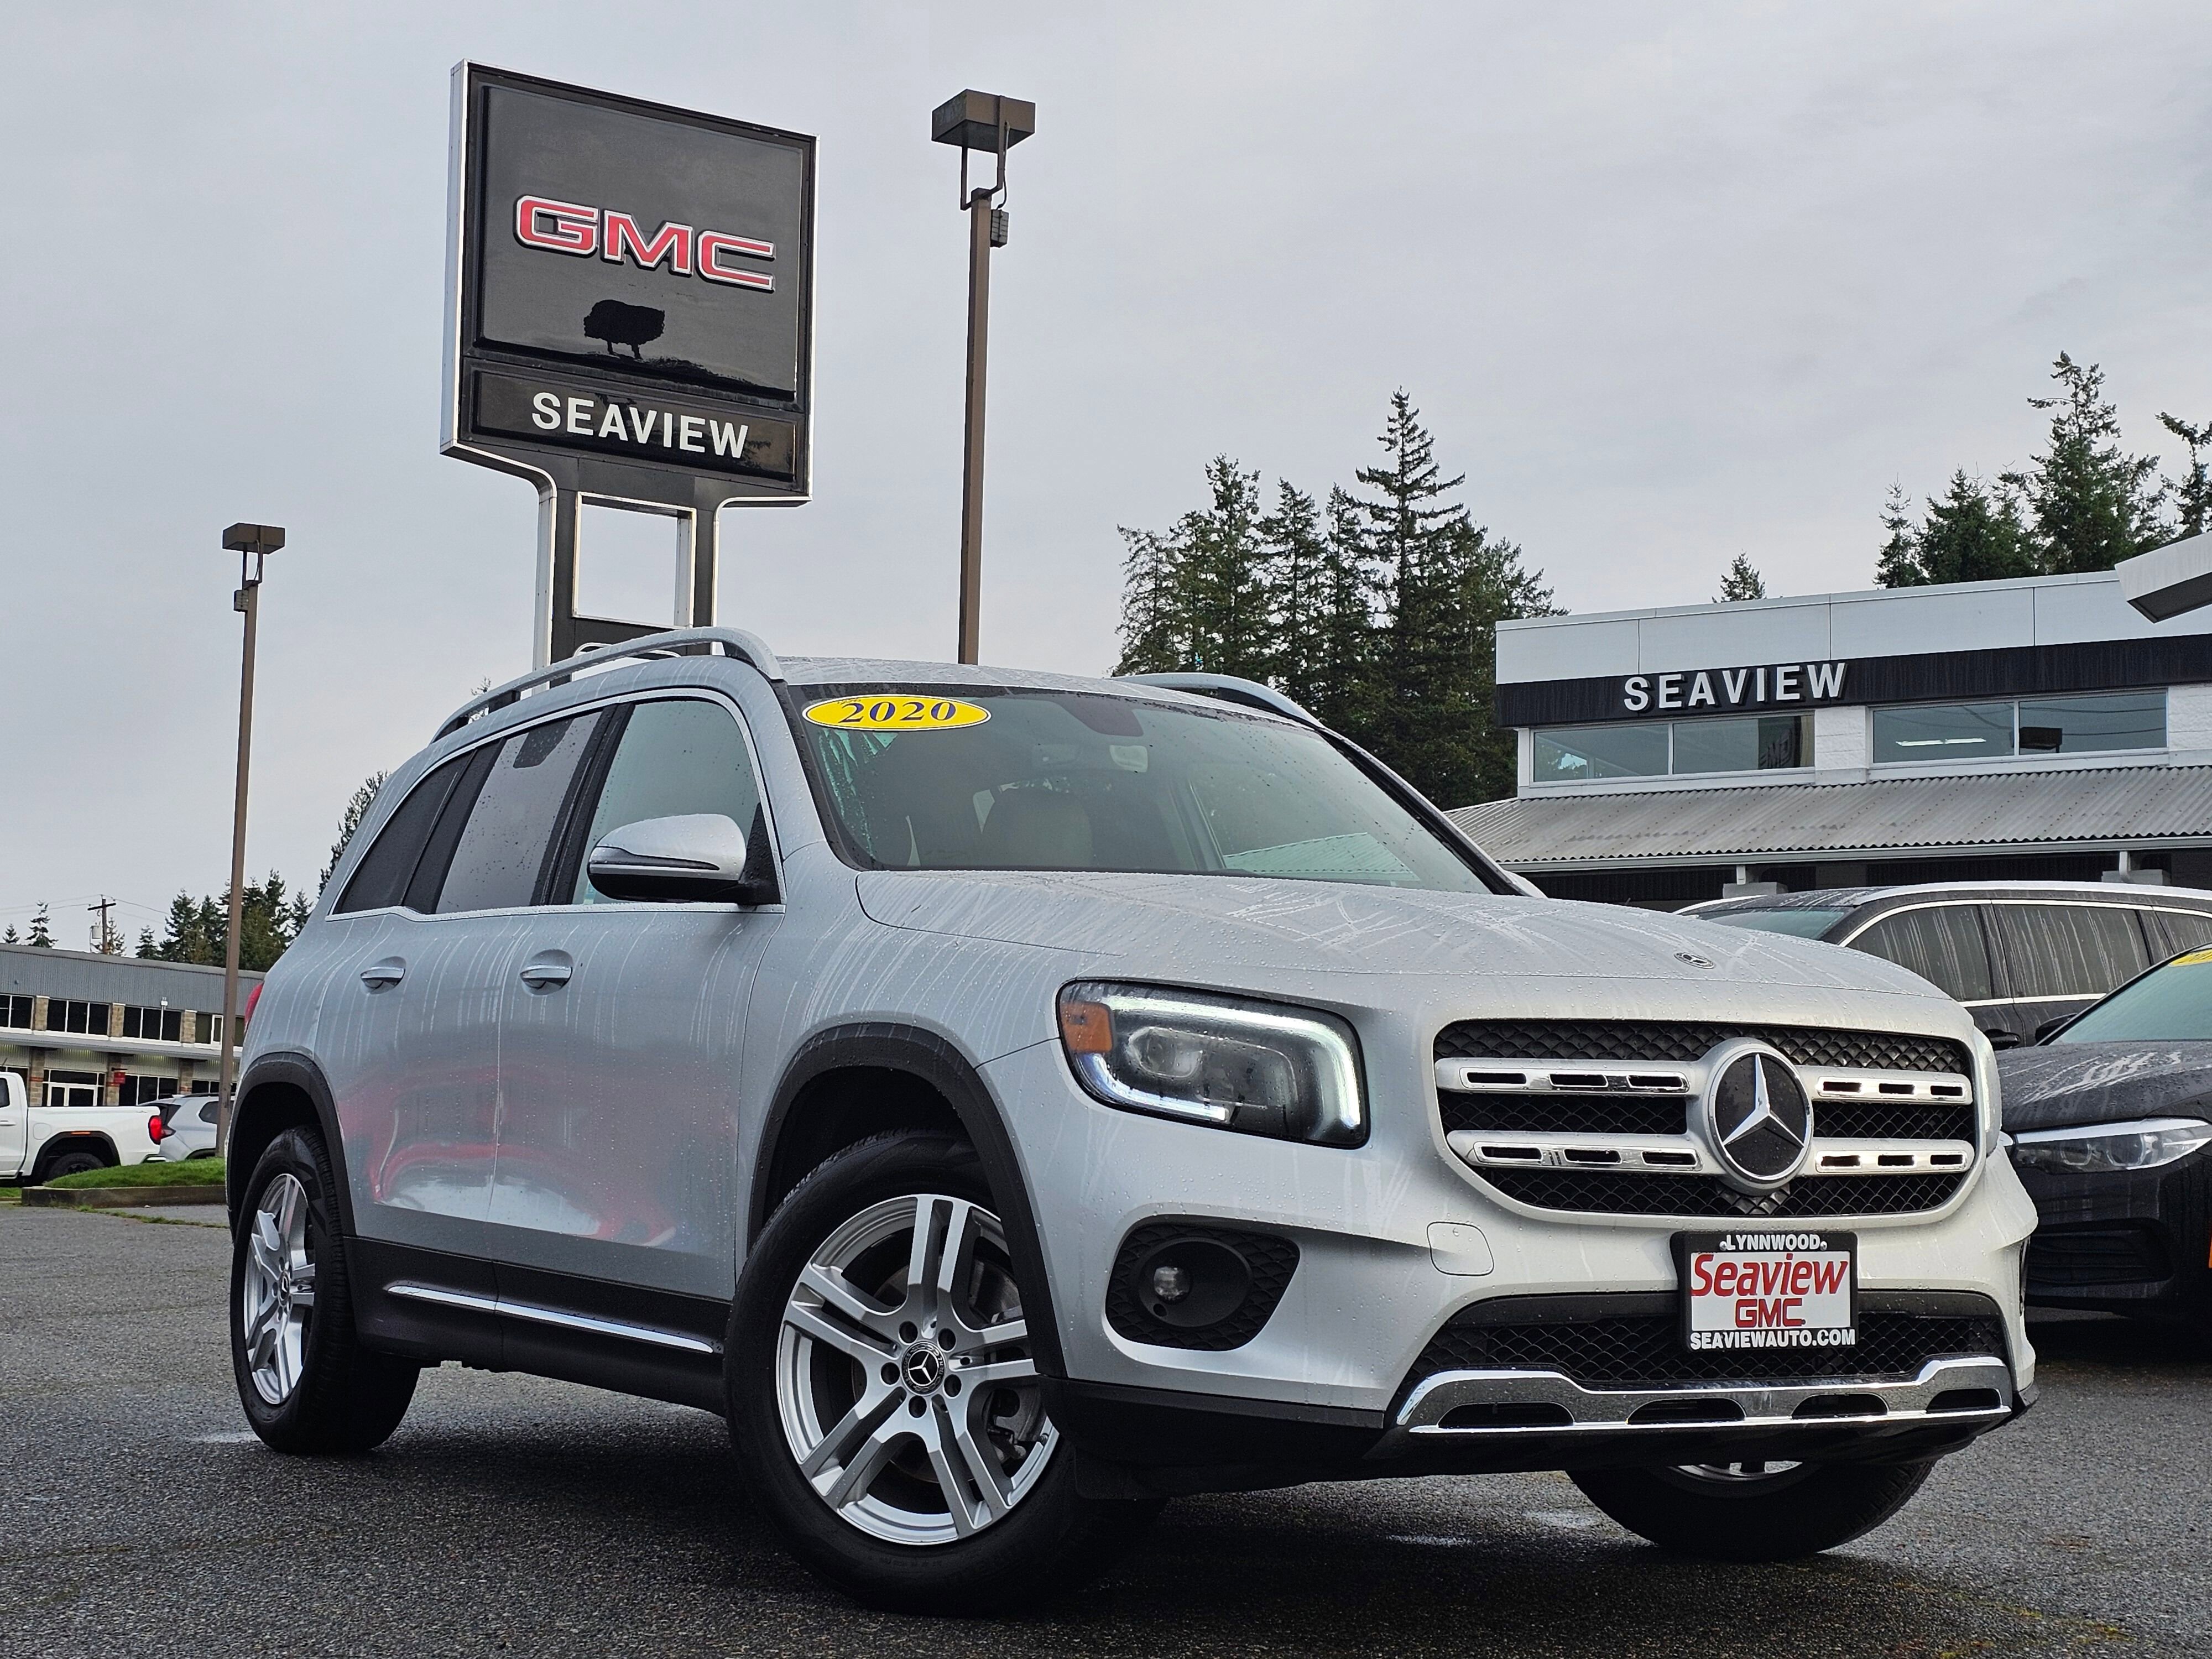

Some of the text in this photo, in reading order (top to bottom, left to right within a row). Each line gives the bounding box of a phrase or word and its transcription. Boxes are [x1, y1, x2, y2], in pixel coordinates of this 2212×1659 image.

[515, 195, 775, 291] GMC
[531, 392, 748, 458] SEAVIEW
[1624, 663, 1845, 711] SEAVIEW
[838, 702, 956, 723] 2020
[1726, 1234, 1820, 1250] LYNNWOOD
[1691, 1253, 1848, 1297] Seaview
[1735, 1298, 1803, 1327] GMC
[1690, 1329, 1855, 1350] SEAVIEWAUTO.COM
